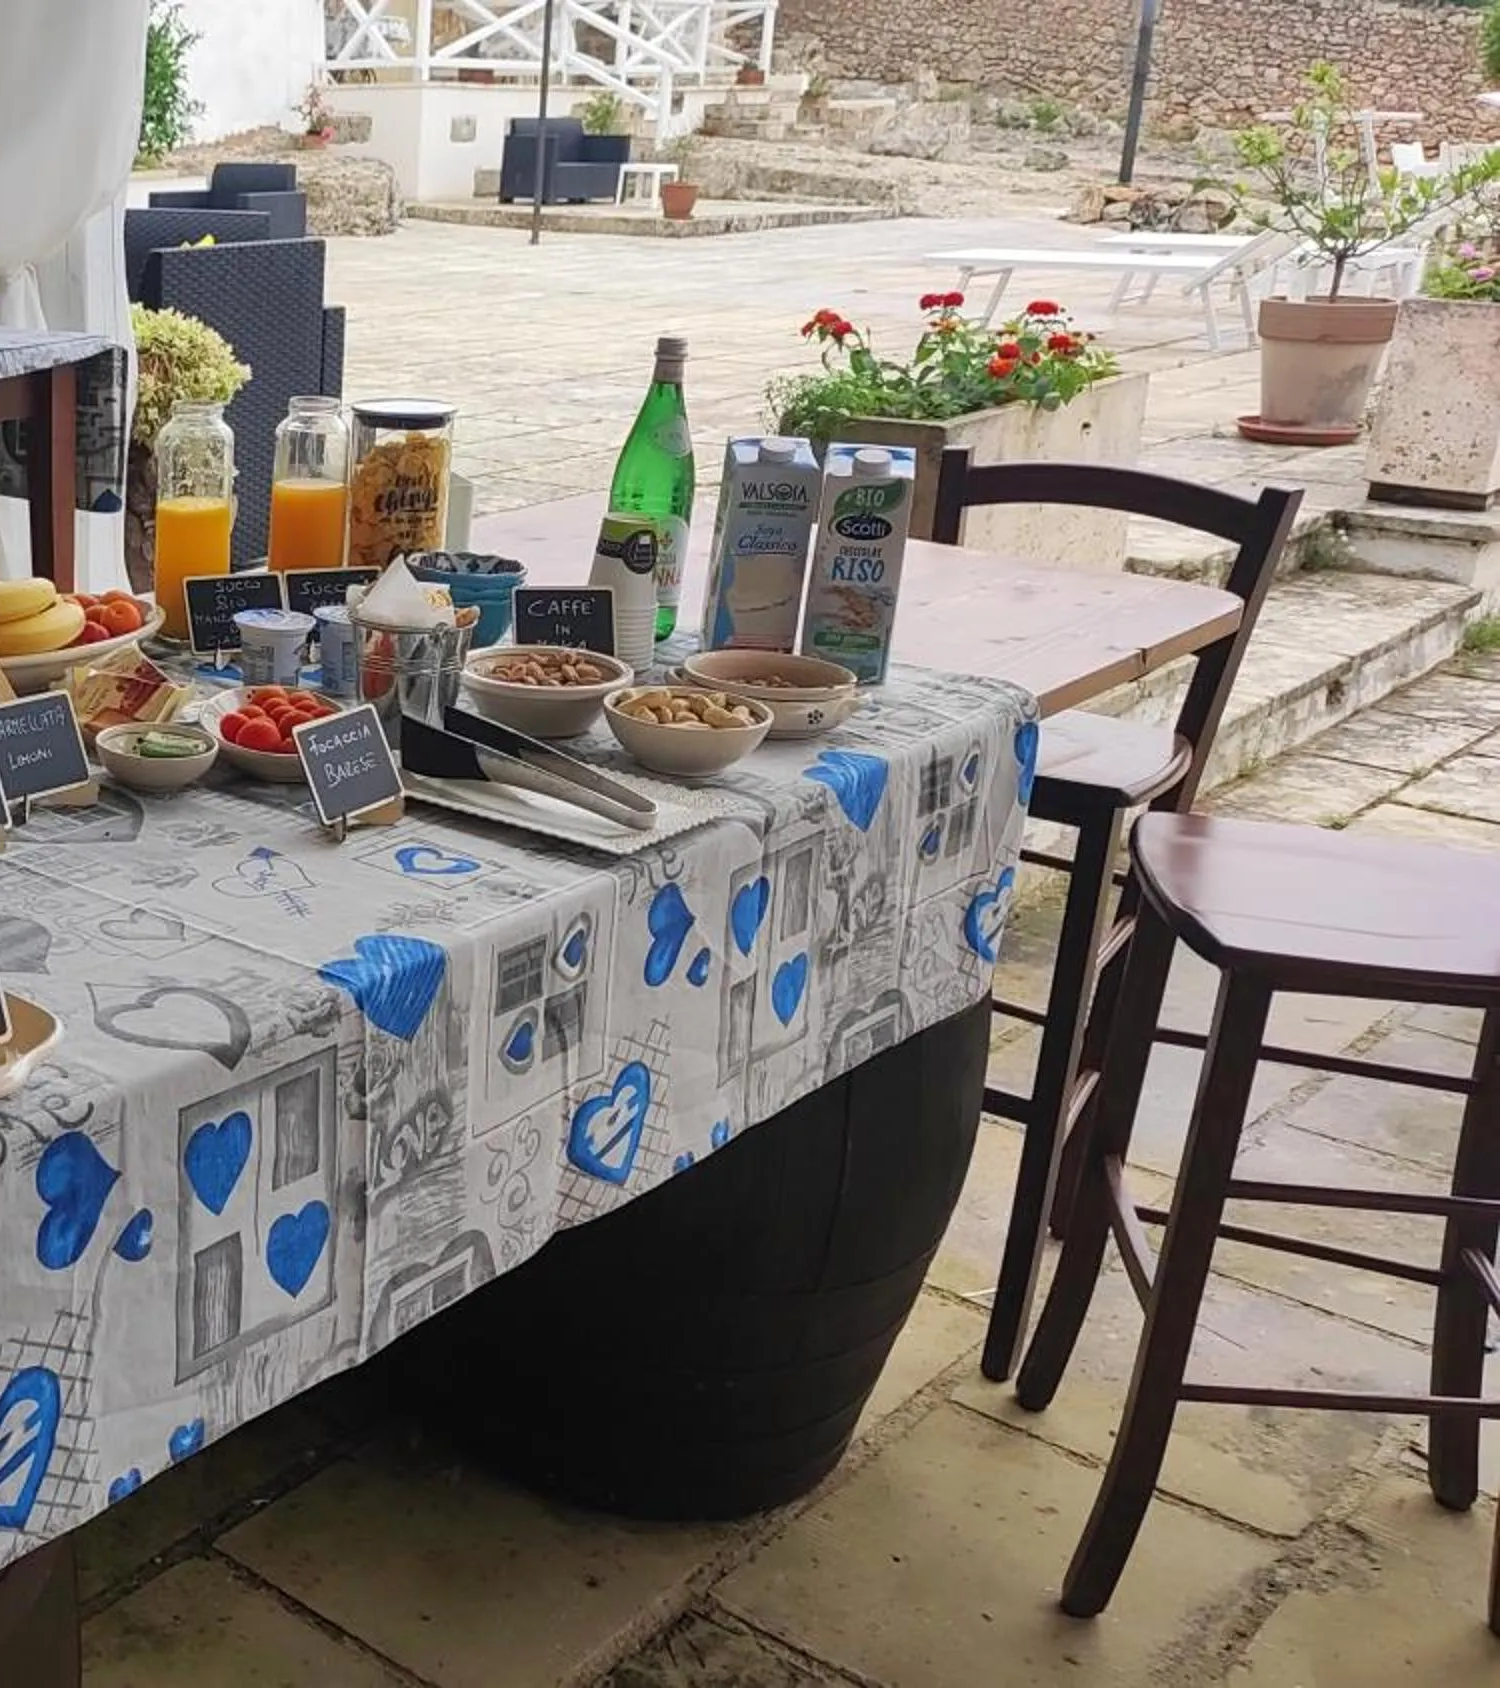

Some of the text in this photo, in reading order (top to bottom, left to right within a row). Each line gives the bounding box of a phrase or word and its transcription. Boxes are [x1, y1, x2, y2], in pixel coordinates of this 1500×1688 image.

[855, 487, 885, 507] BIO
[832, 556, 885, 582] RISO
[299, 581, 348, 595] SUCC
[555, 623, 571, 635] IN
